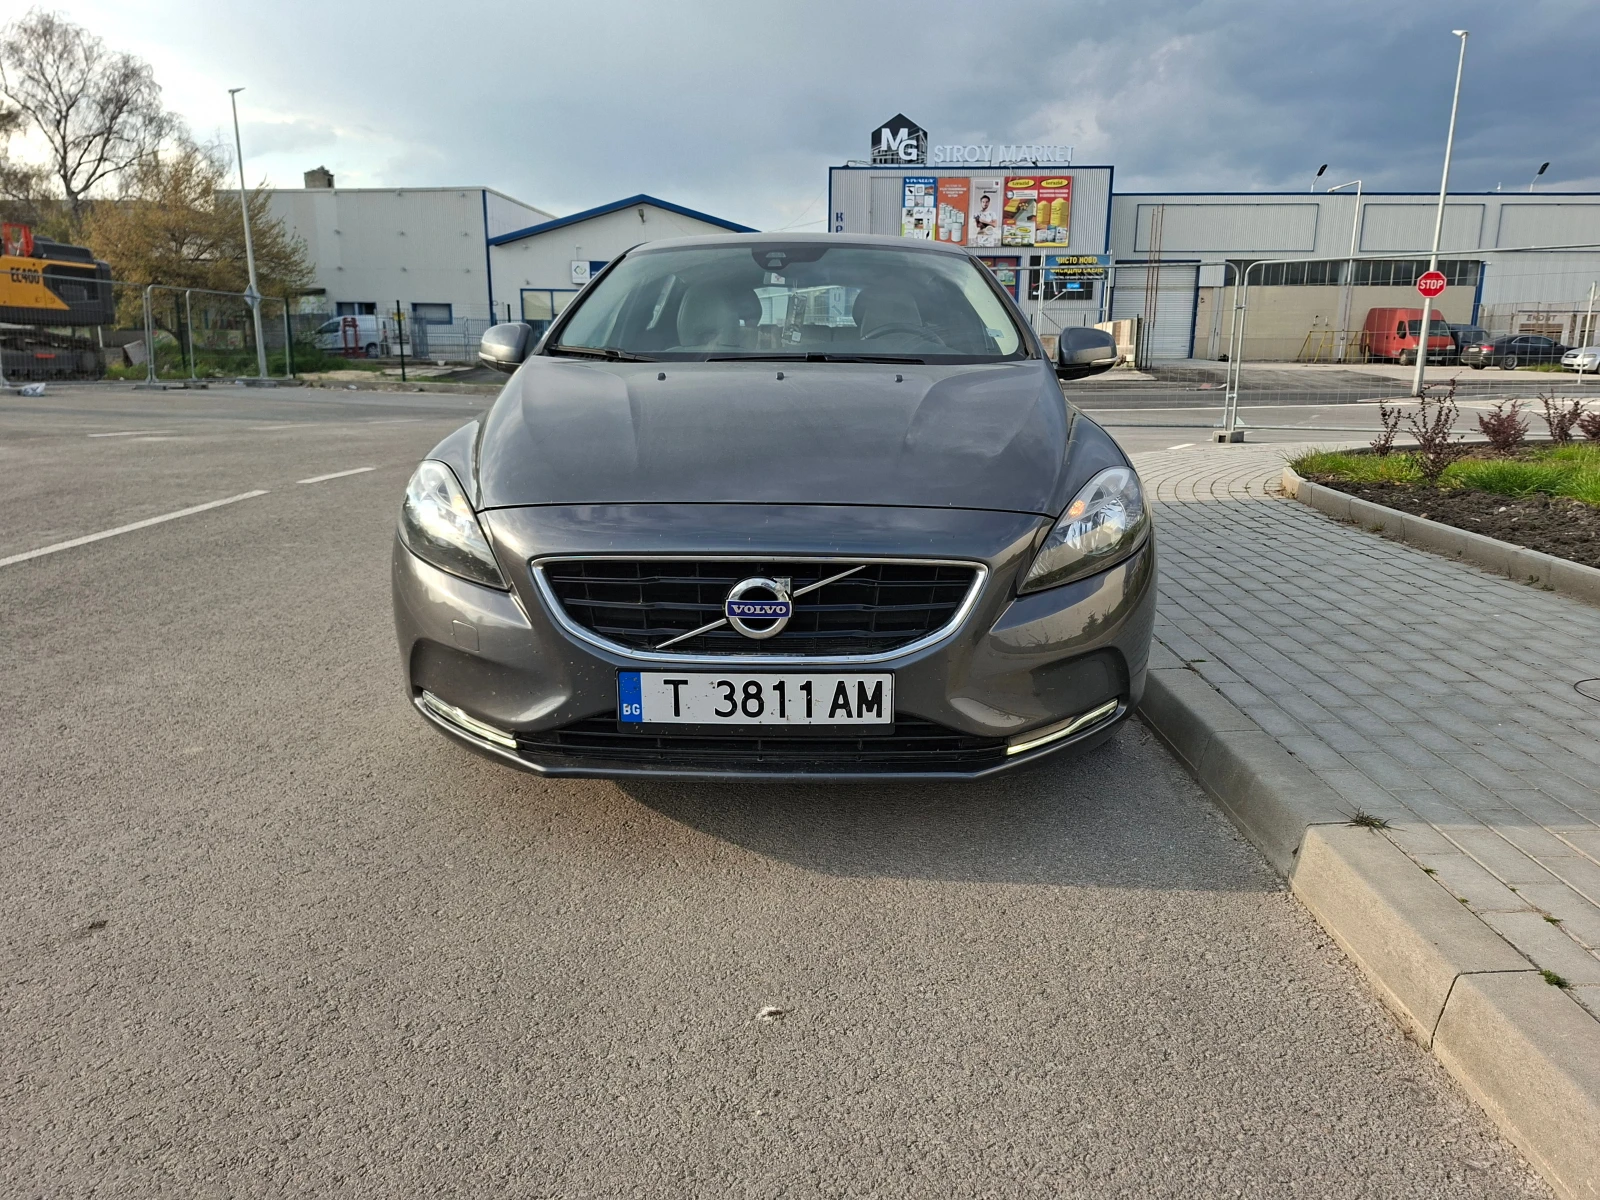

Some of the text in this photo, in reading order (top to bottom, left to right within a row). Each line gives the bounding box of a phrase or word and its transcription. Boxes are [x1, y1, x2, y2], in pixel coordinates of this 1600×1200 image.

[881, 128, 917, 161] MG
[934, 145, 1073, 162] STROY MARKET
[1056, 256, 1098, 264] ЧИСТО НОВО
[1420, 280, 1444, 289] STOP
[731, 605, 787, 614] VOLVO
[663, 679, 883, 718] T 3811 AM
[623, 704, 641, 715] BG
